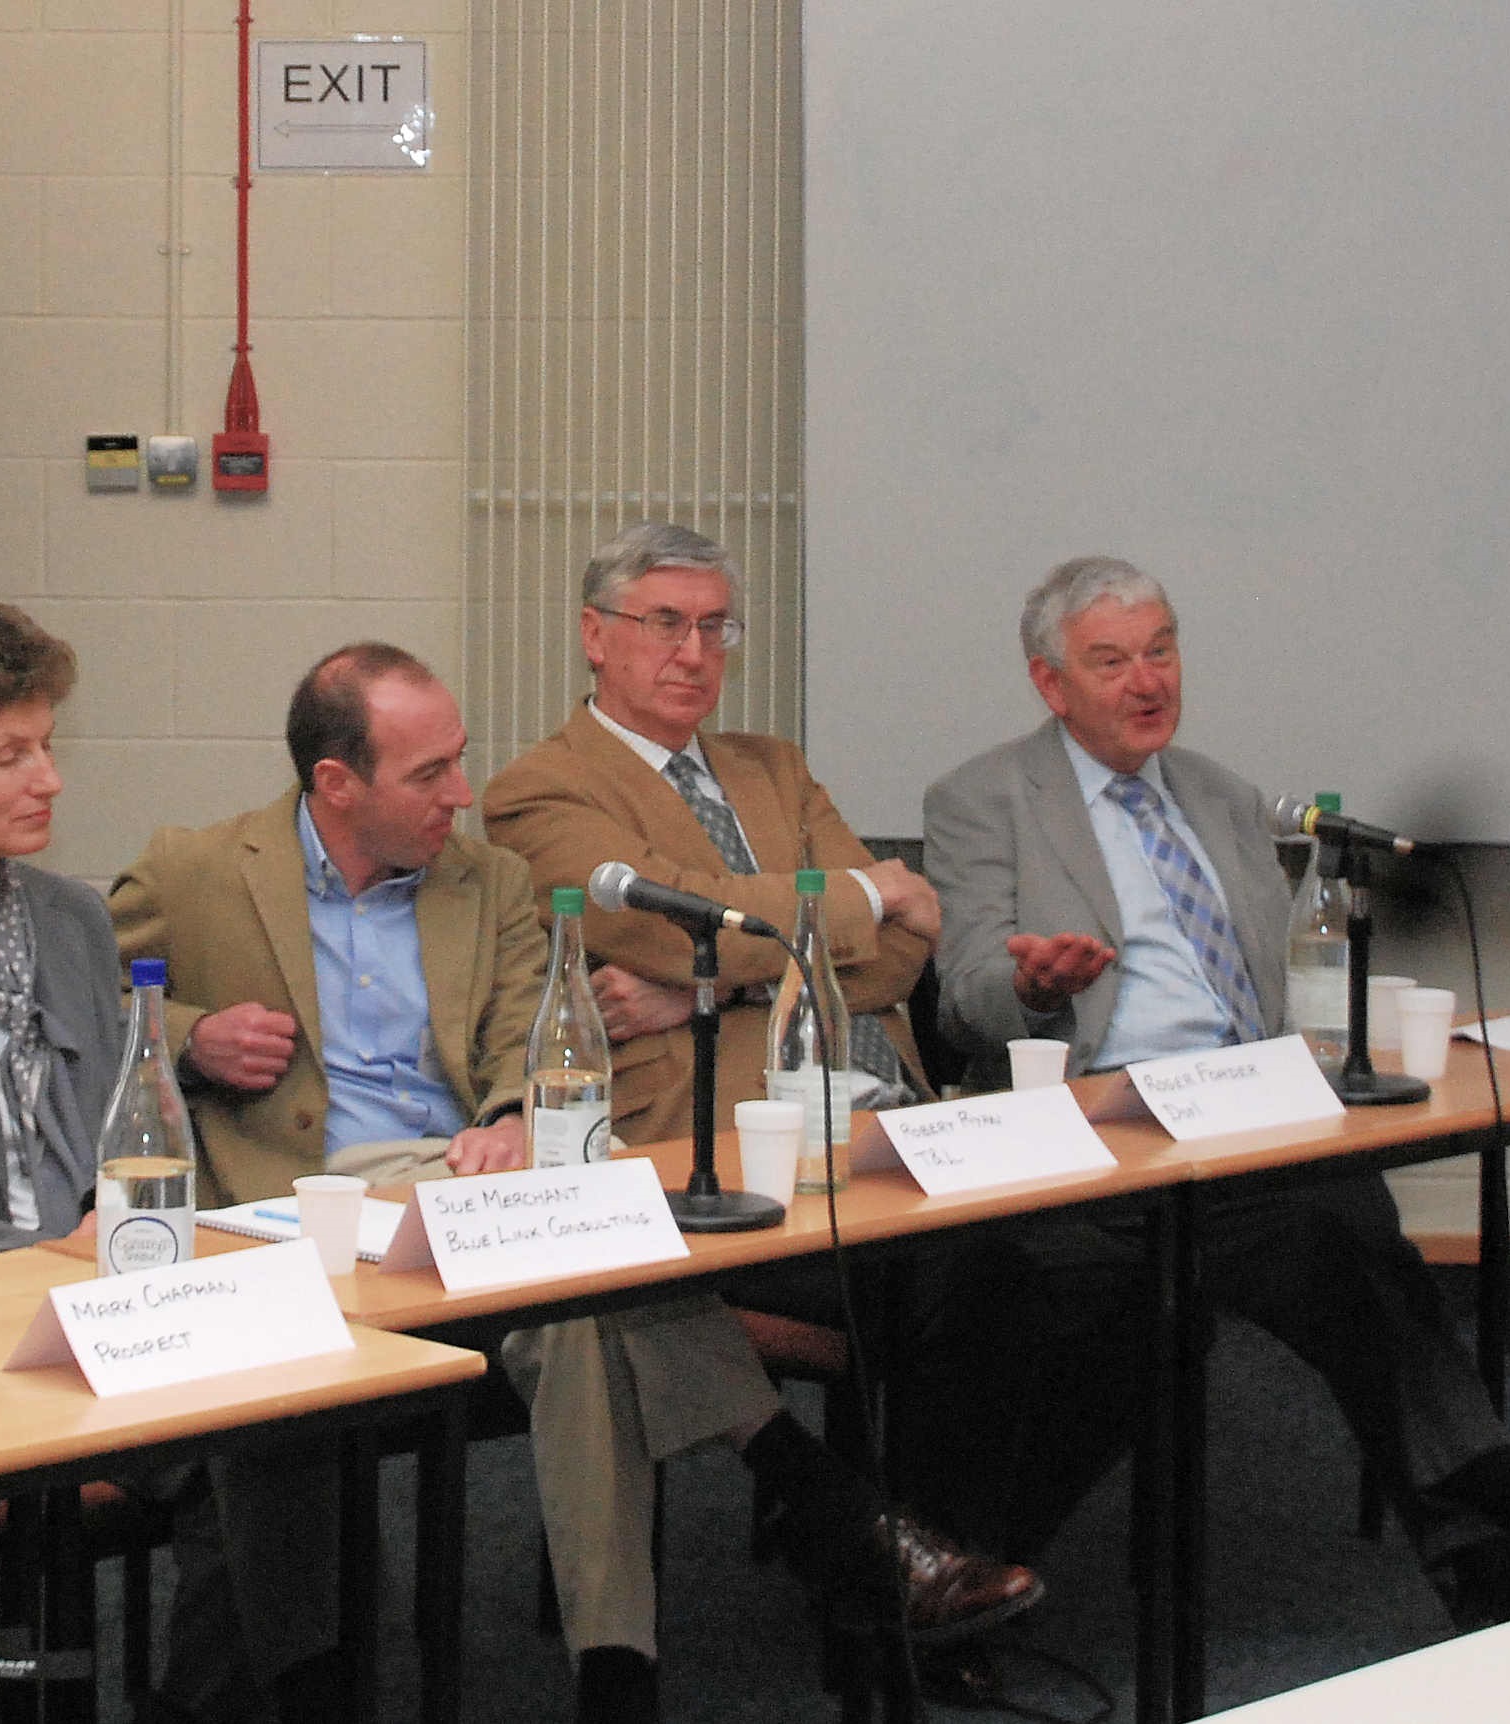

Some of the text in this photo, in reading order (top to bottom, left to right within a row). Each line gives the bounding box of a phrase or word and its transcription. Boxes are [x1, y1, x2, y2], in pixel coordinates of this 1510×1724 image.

[283, 64, 401, 103] EXIT
[434, 1184, 580, 1215] SUE MERCHANT
[445, 1211, 652, 1253] BLUE LINK CONSULTING
[71, 1280, 238, 1321] MARK CHAPMAN
[93, 1330, 192, 1365] PROSPECT
